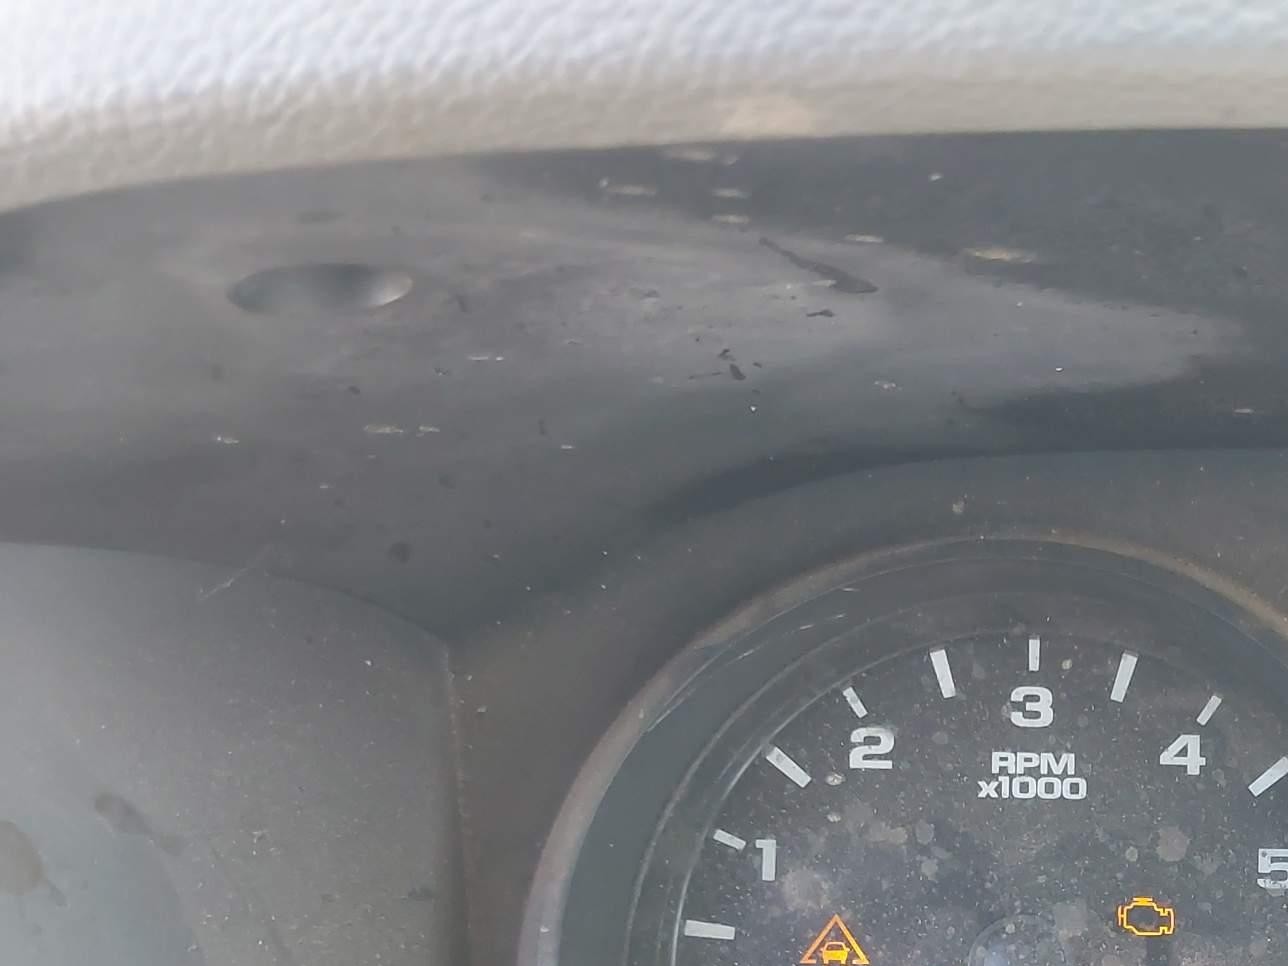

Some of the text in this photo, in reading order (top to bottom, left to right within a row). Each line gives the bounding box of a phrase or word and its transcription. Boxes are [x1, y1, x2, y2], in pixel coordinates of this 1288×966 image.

[1010, 686, 1054, 728] 3
[849, 727, 895, 769] 2
[991, 751, 1075, 775] RPM
[1159, 734, 1206, 775] 4
[977, 776, 1087, 800] x1000
[755, 839, 776, 881] 1
